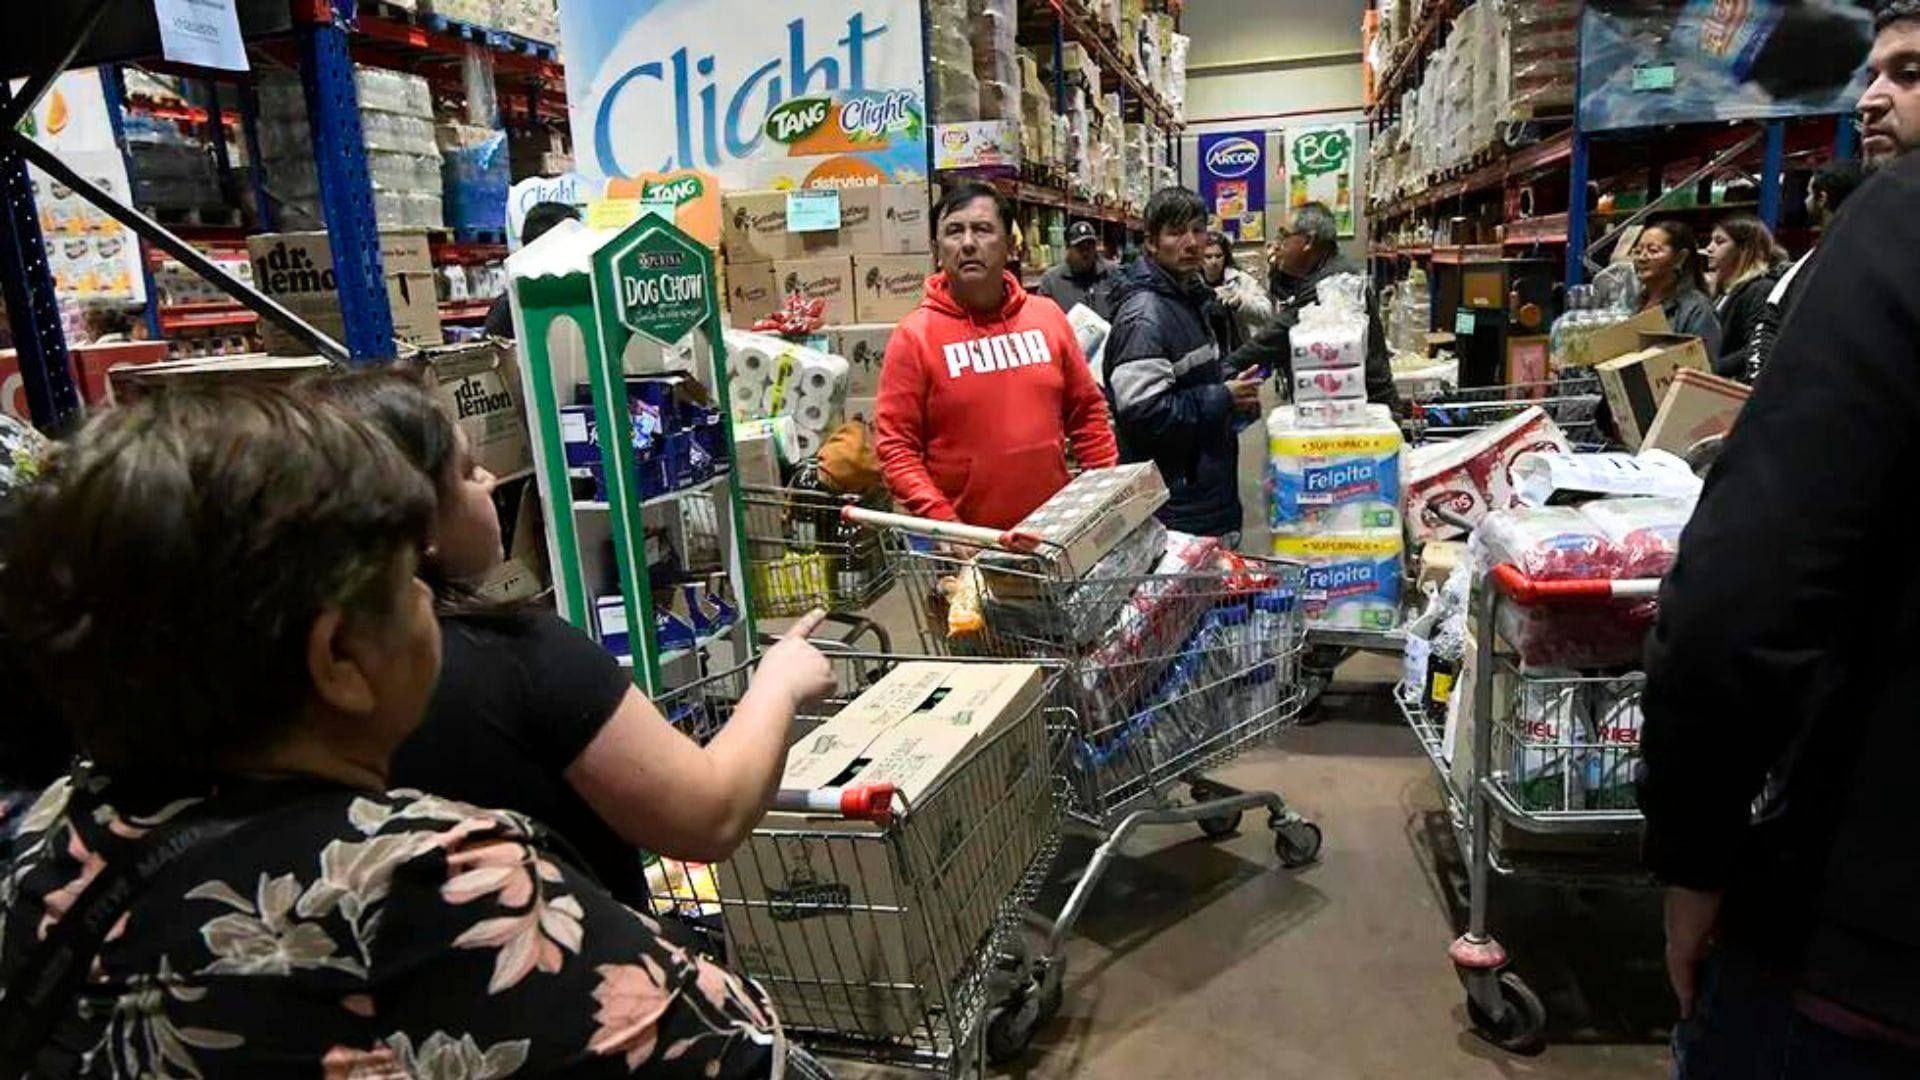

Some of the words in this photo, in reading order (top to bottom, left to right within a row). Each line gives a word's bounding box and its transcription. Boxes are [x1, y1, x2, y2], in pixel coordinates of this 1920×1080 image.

[594, 12, 888, 180] Clight
[771, 102, 827, 140] TANG
[841, 93, 910, 133] Clight
[1208, 151, 1258, 166] ARCOR
[1297, 133, 1344, 164] BC
[647, 179, 697, 202] TANG
[267, 241, 314, 270] dr.
[256, 256, 337, 295] lemo
[624, 275, 660, 307] DOG
[660, 273, 703, 302] CHOW
[943, 329, 1052, 378] PUMA
[460, 376, 485, 399] dr.
[454, 389, 512, 420] lemon
[1308, 464, 1372, 490] Felpita
[1309, 564, 1372, 588] Felpita
